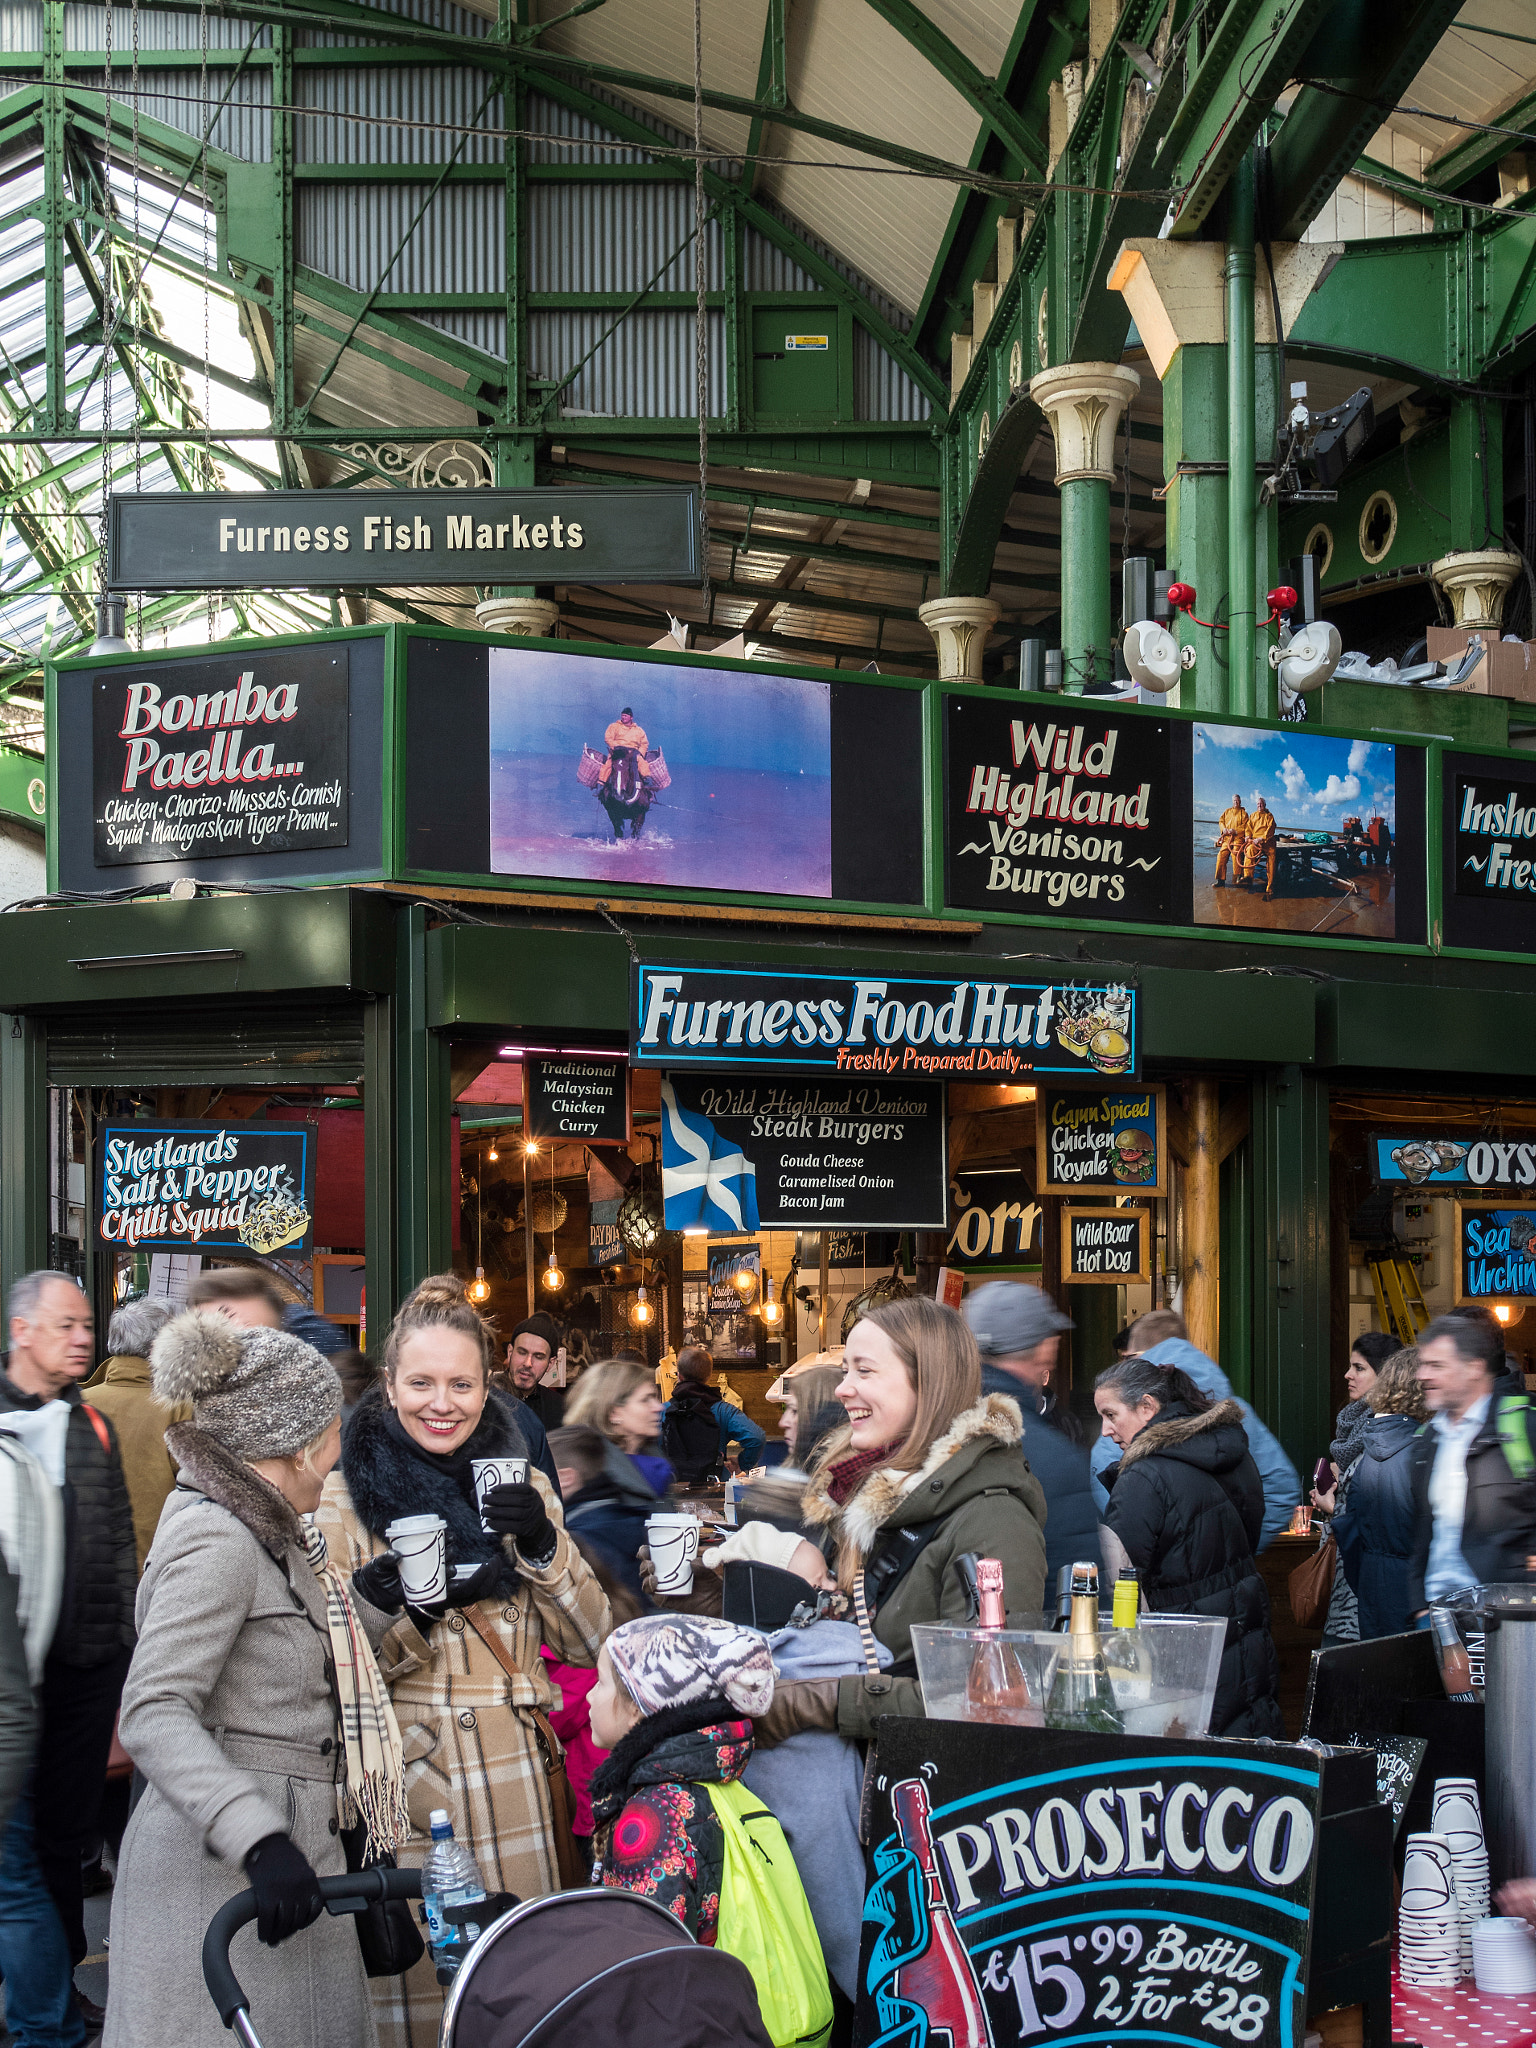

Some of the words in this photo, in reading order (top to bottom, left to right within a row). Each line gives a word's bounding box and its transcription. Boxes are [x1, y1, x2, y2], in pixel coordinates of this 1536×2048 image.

[219, 518, 350, 553] Furness
[364, 515, 433, 552] Fish
[446, 514, 585, 550] Markets
[118, 671, 300, 739] Bomba
[122, 730, 305, 792] Paella...
[1009, 718, 1118, 780] Wild
[164, 793, 222, 818] Chorizo
[227, 784, 287, 813] Mussels
[291, 779, 342, 807] Cornish
[966, 764, 1151, 830] Highland
[106, 821, 147, 852] Squid
[245, 811, 285, 845] Tiger
[990, 820, 1123, 865] Venison
[986, 856, 1126, 908] Burgers
[637, 974, 846, 1047] Furness
[844, 981, 970, 1049] Food
[966, 984, 1055, 1050] Hut
[540, 1061, 617, 1078] Traditional
[836, 1047, 900, 1074] Freshly
[902, 1048, 975, 1073] Prepared
[976, 1049, 1033, 1076] Daily...
[542, 1080, 614, 1097] Malaysian
[551, 1099, 606, 1115] Chicken
[701, 1088, 755, 1115] Wild
[760, 1089, 852, 1119] Highland
[856, 1089, 928, 1115] Venison
[559, 1119, 599, 1136] Curry
[750, 1115, 813, 1138] Steak
[818, 1117, 905, 1145] Burgers
[1051, 1099, 1098, 1129] Cajun
[1100, 1095, 1150, 1126] Spiced
[104, 1130, 240, 1178] Shetlands
[1051, 1124, 1115, 1152] Chicken
[780, 1153, 820, 1168] Gouda
[823, 1153, 864, 1168] Cheese
[1053, 1150, 1109, 1182] Royale
[1467, 1141, 1536, 1185] OYS
[106, 1172, 159, 1209] Salt
[160, 1168, 183, 1202] &
[183, 1163, 288, 1203] Pepper
[778, 1174, 856, 1188] Caramelised
[859, 1175, 895, 1188] Onion
[100, 1201, 169, 1247] Chilli
[170, 1194, 249, 1242] Squid
[779, 1194, 818, 1208] Bacon
[819, 1194, 845, 1210] Jam
[1075, 1222, 1103, 1247] Wild
[1104, 1221, 1135, 1243] Boar
[1467, 1218, 1511, 1258] Sea
[1077, 1250, 1101, 1272] Hot
[1105, 1248, 1132, 1272] Dog
[936, 1781, 1315, 1916] PROSECCO
[1140, 1923, 1263, 1983] Bottle
[1092, 1975, 1122, 2020] 2
[1115, 1975, 1187, 2026] For
[1189, 1981, 1271, 2041] £28
